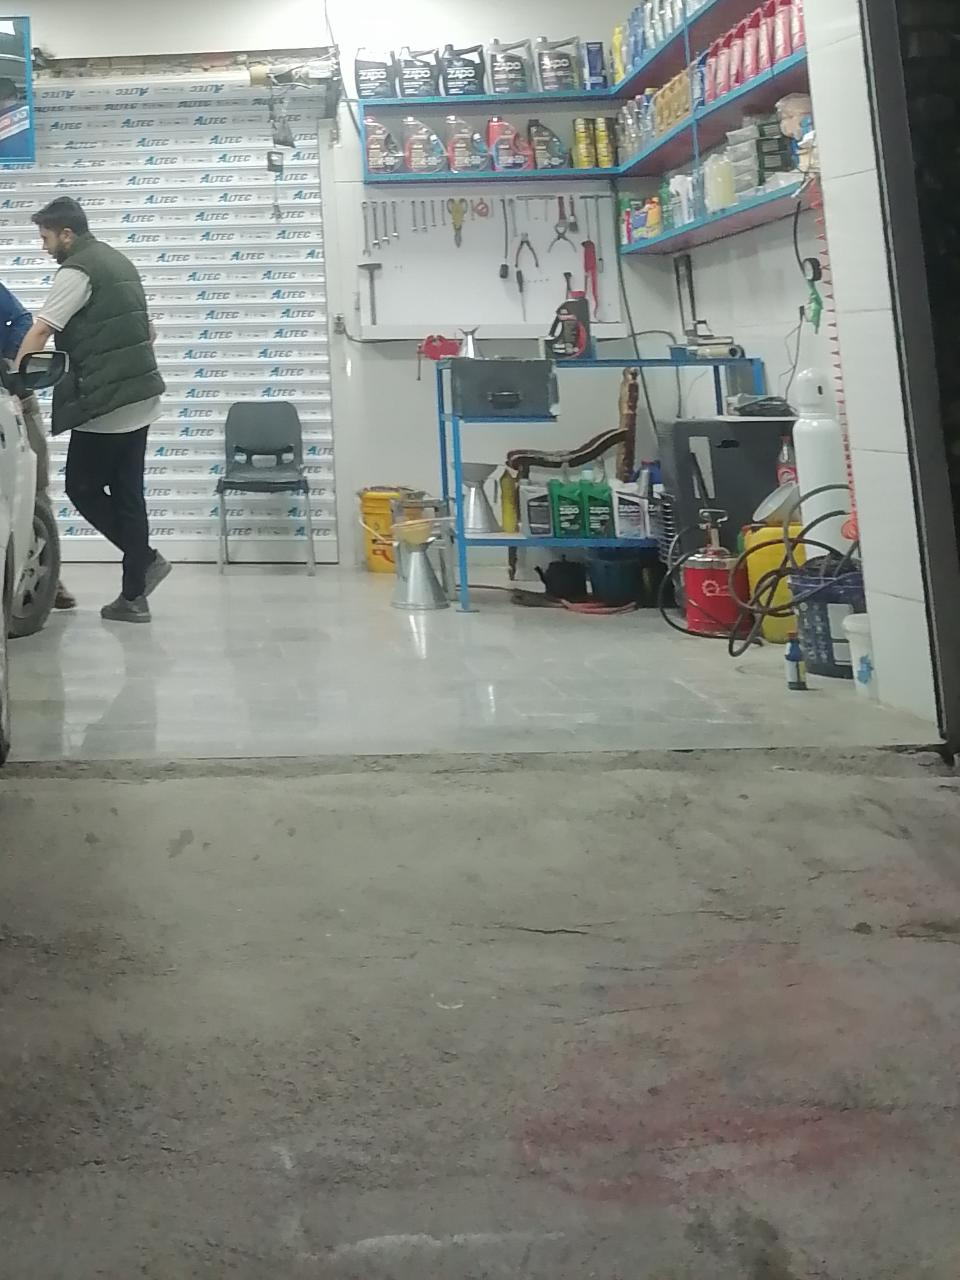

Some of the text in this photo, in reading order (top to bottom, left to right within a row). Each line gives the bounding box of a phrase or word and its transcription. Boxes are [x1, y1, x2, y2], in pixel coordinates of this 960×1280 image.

[49, 121, 82, 131] ALTEC
[121, 119, 154, 128] ALTEC
[193, 116, 227, 125] ALTEC
[136, 138, 170, 147] ALTEC
[209, 135, 243, 144] ALTEC
[144, 156, 178, 165] ALTEC
[217, 153, 251, 163] ALTEC
[291, 151, 319, 160] ALTE
[126, 176, 160, 185] ALTEC
[200, 174, 234, 183] ALTEC
[144, 195, 178, 204] ALTEC
[217, 193, 252, 202] ALTEC
[121, 214, 155, 223] ALTEC
[195, 212, 229, 221] ALTEC
[126, 233, 160, 243] ALTEC
[200, 232, 234, 241] ALTEC
[276, 230, 311, 239] ALTEC
[156, 253, 190, 262] ALTEC
[230, 251, 265, 261] ALTEC
[186, 270, 296, 281] ALTEC ALTEC
[195, 289, 306, 300] ALTEC ALTEC
[205, 308, 316, 319] ALTEC ALTEC
[198, 329, 309, 339] ALTEC ALTEC
[183, 348, 292, 359] ALTEC ALTEC
[193, 367, 304, 378] ALTEC ALTEC
[185, 387, 296, 397] ALTEC ALTEC
[178, 408, 213, 417] ALTEC
[179, 427, 214, 437] ALTEC
[154, 446, 334, 456] ALTEC ALTE
[143, 488, 171, 496] LTEC
[148, 508, 168, 516] TEC
[209, 507, 244, 516] ATEC
[295, 526, 330, 536] ATEC
